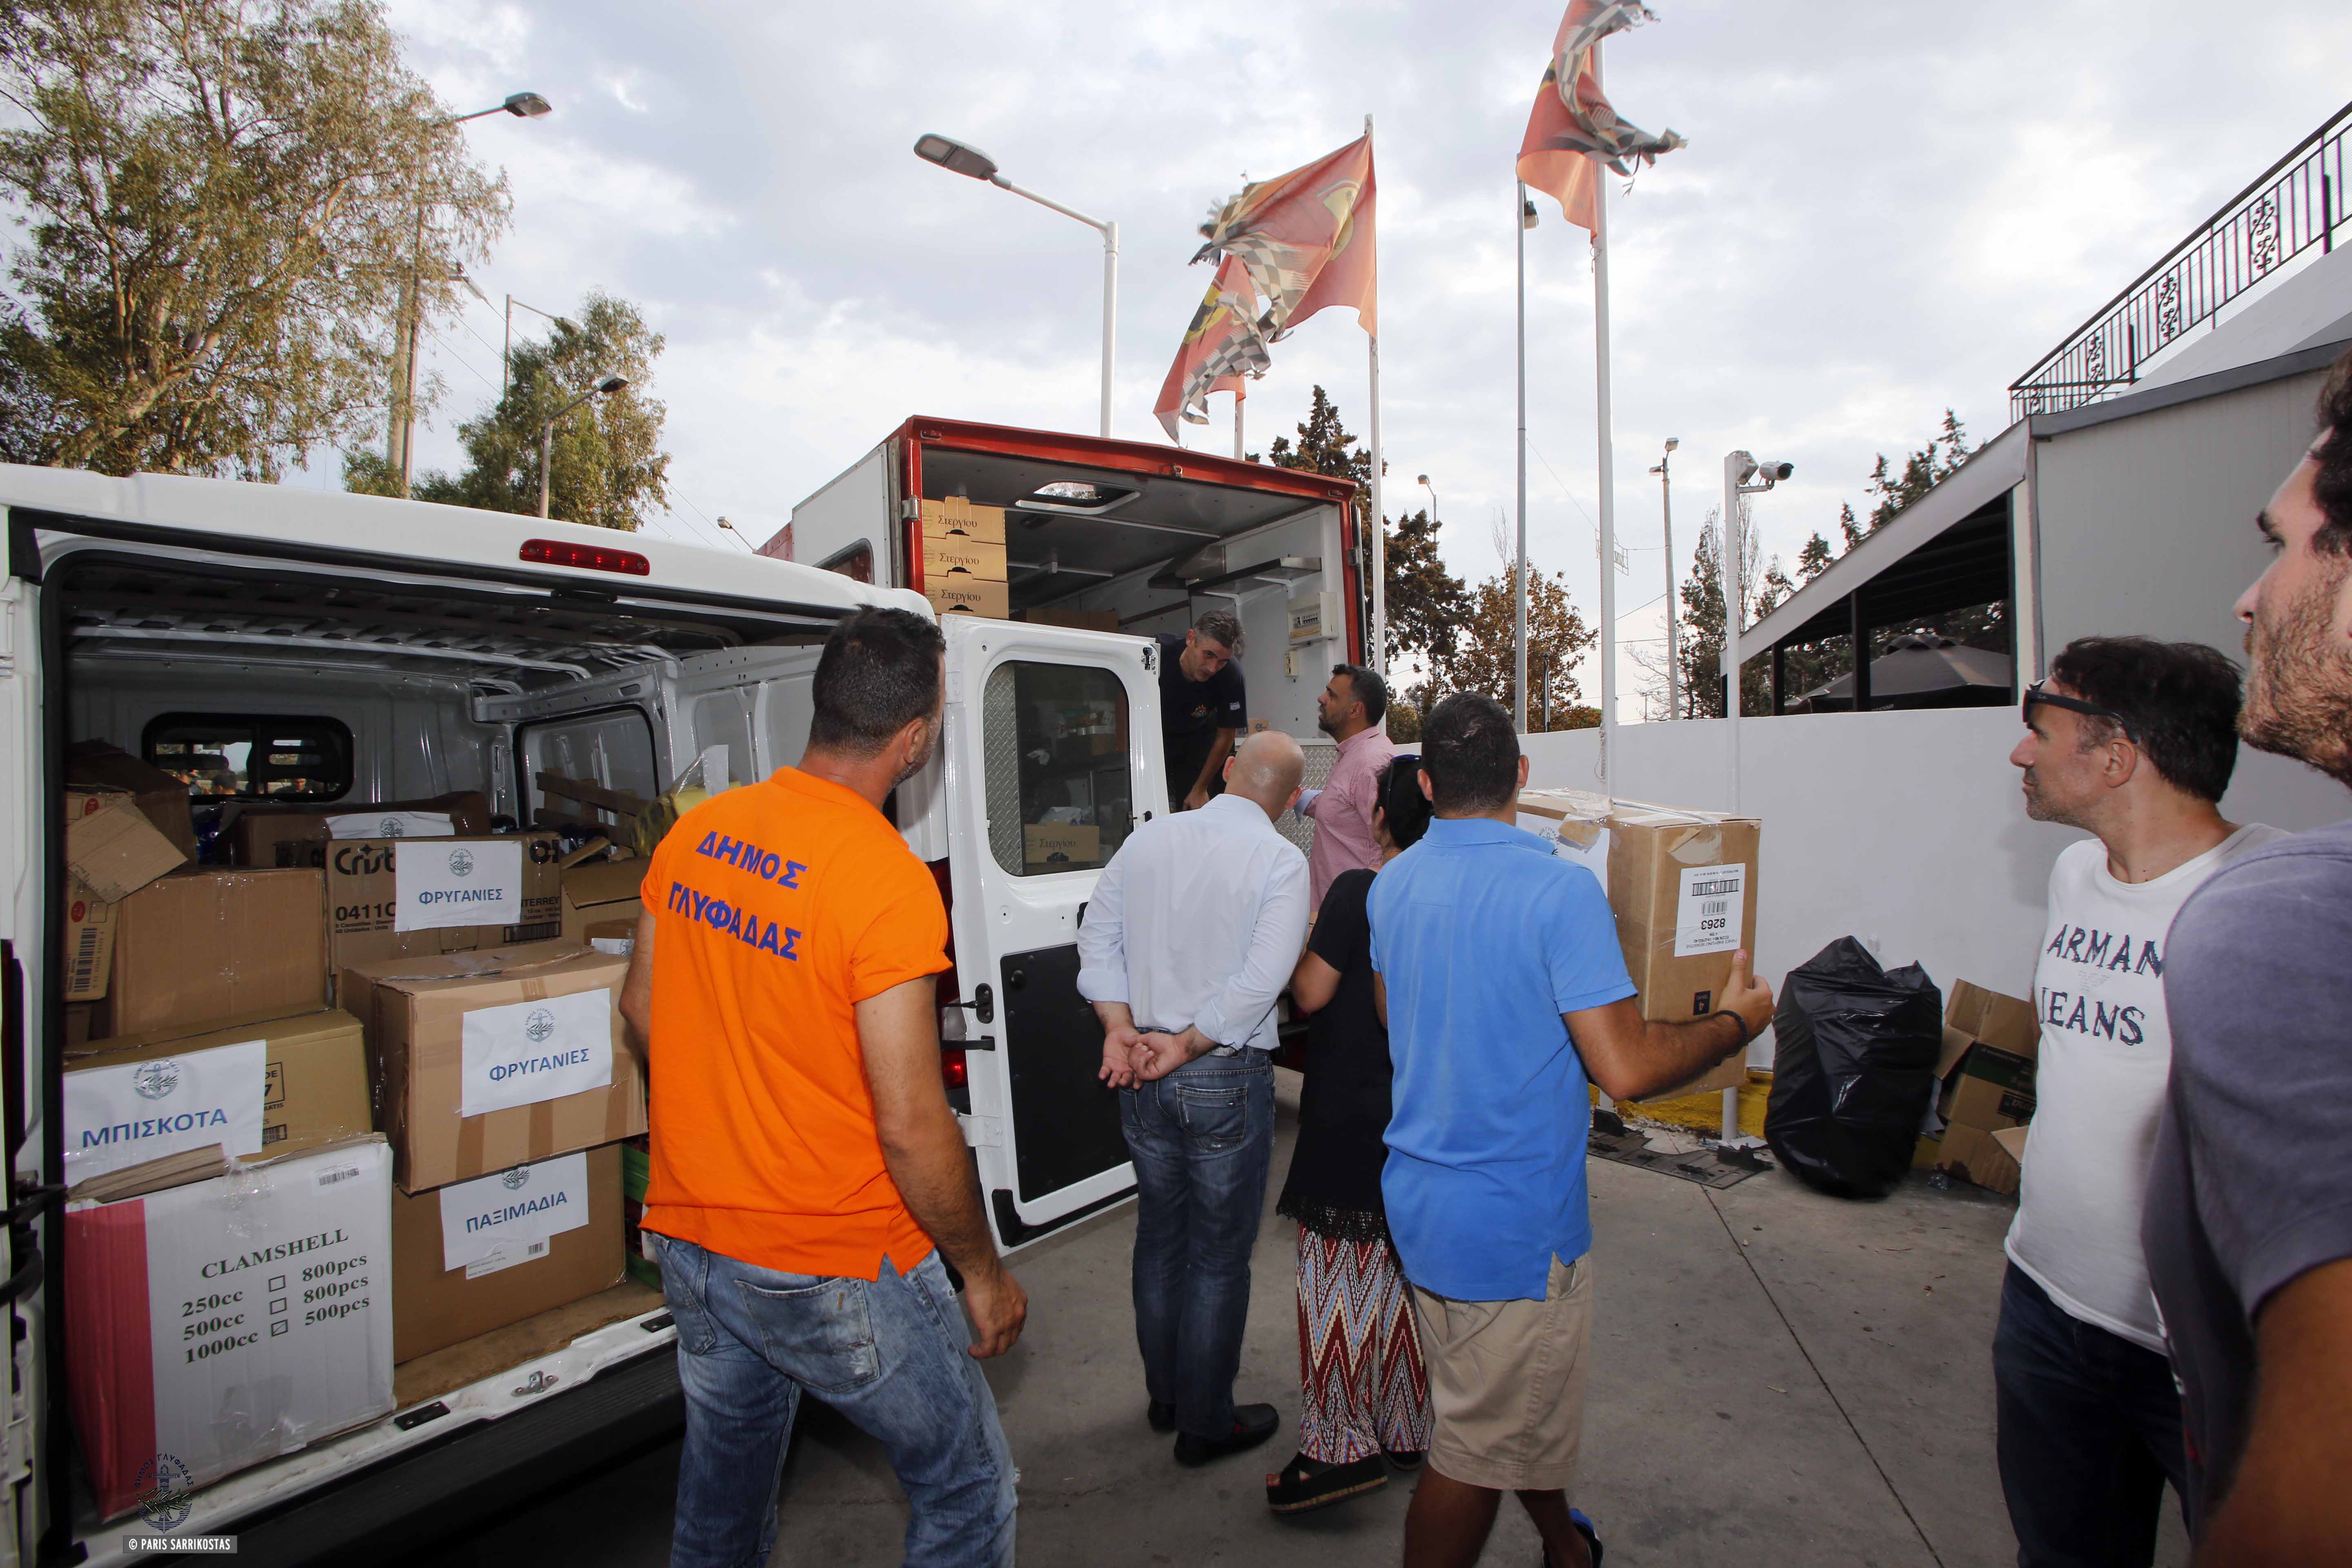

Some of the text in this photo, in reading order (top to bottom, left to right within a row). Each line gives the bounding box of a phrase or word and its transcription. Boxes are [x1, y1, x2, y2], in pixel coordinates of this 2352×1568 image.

[938, 514, 978, 530] Στεργίου
[940, 552, 980, 566] Στεργίου
[941, 589, 981, 603] Στεργίου
[335, 846, 396, 875] Crist
[695, 830, 808, 890] ΔΗΜΟΣ
[1039, 837, 1076, 850] Στεργίου
[419, 888, 503, 905] ΦΡΥΓΑΝΙΕΣ
[668, 881, 802, 962] ΓΛΥΦΑΔΑΣ
[1701, 918, 1726, 930] 8263
[2046, 924, 2165, 979] ARMAN
[2039, 986, 2145, 1047] JEANS
[489, 1048, 590, 1082] ΦΡΥΓΑΝΙΕΣ
[82, 1108, 228, 1148] ΜΠΙΣΚΟΤΑ
[466, 1190, 568, 1234] ΠΑΞΙΜΑΔΙΑ
[201, 1228, 349, 1279] CLAMSHELL
[181, 1254, 368, 1318] 250cc 800pcs
[183, 1275, 369, 1341] 500cc 800pcs
[185, 1296, 370, 1364] 1000cc 500pcs
